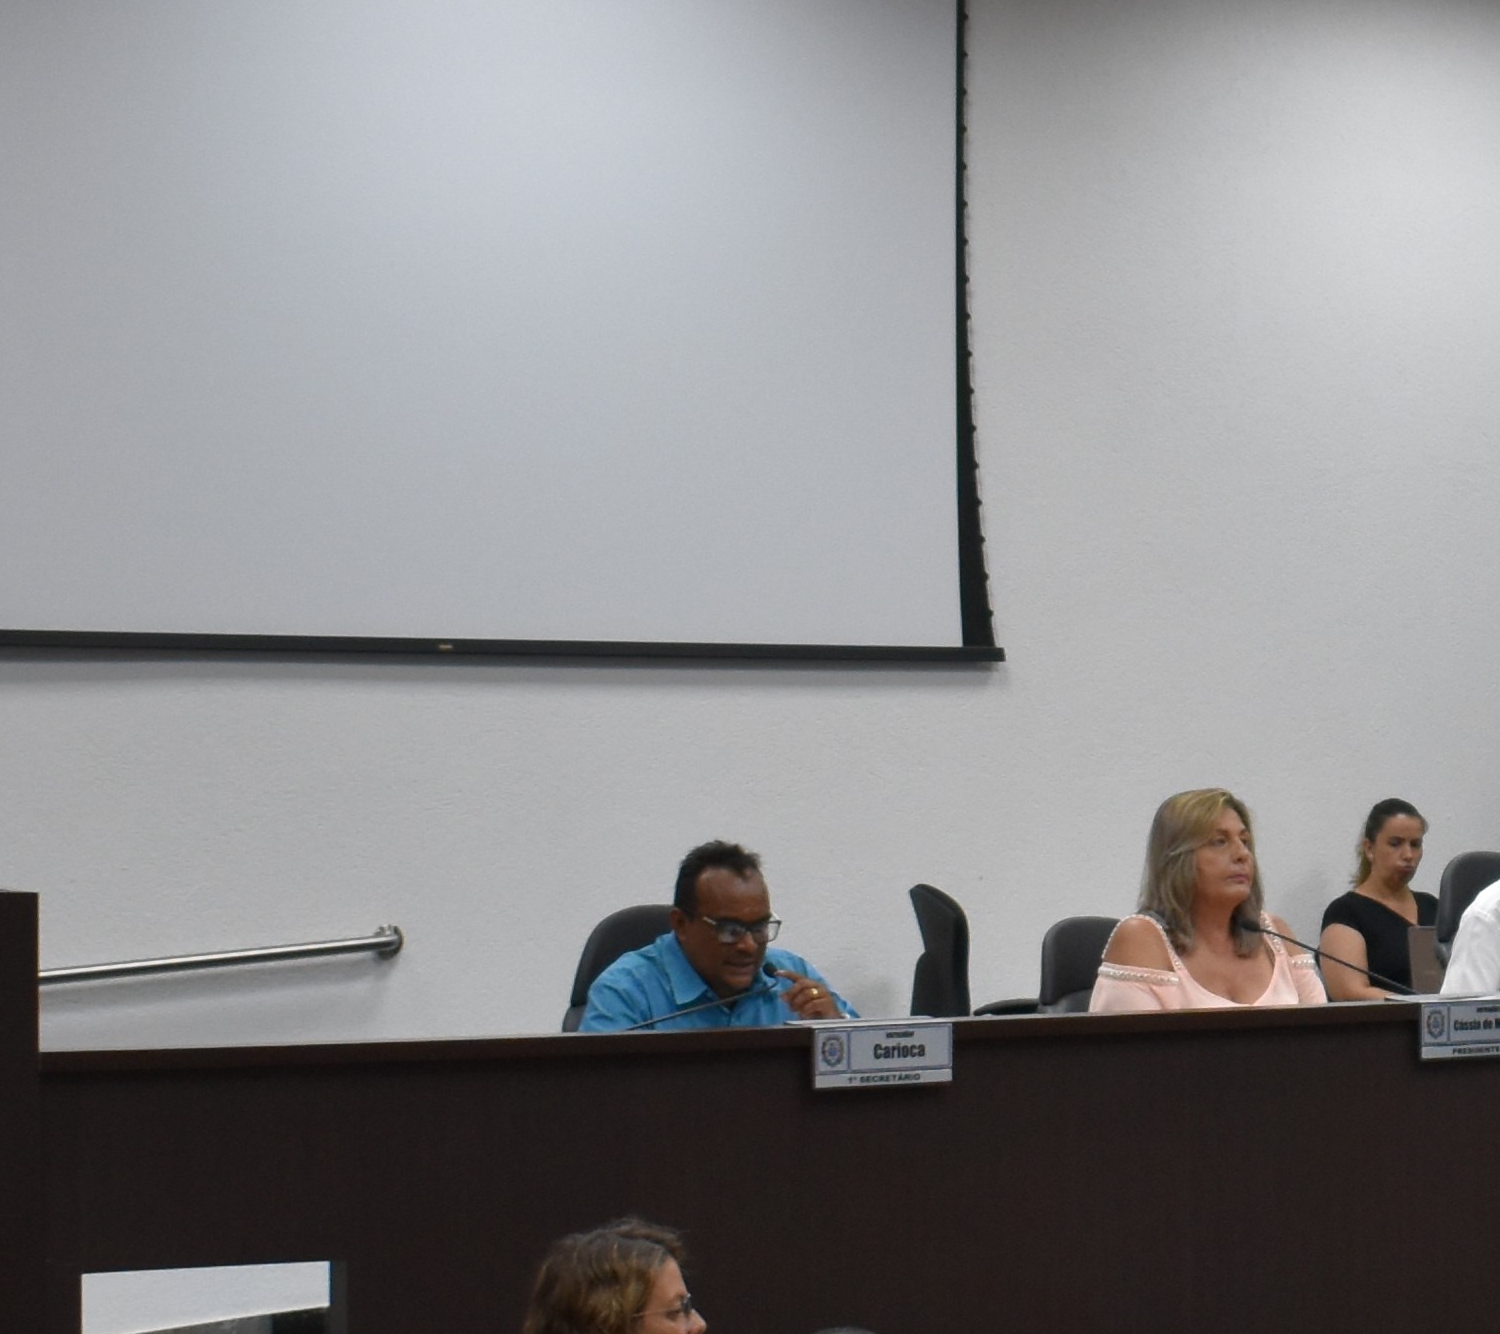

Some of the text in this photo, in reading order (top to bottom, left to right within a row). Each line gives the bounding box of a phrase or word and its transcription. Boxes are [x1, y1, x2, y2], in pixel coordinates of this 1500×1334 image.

[873, 1043, 926, 1060] Carioca
[1452, 1046, 1500, 1055] PRESIDENTE
[859, 1072, 921, 1084] SECRETÁRIO
